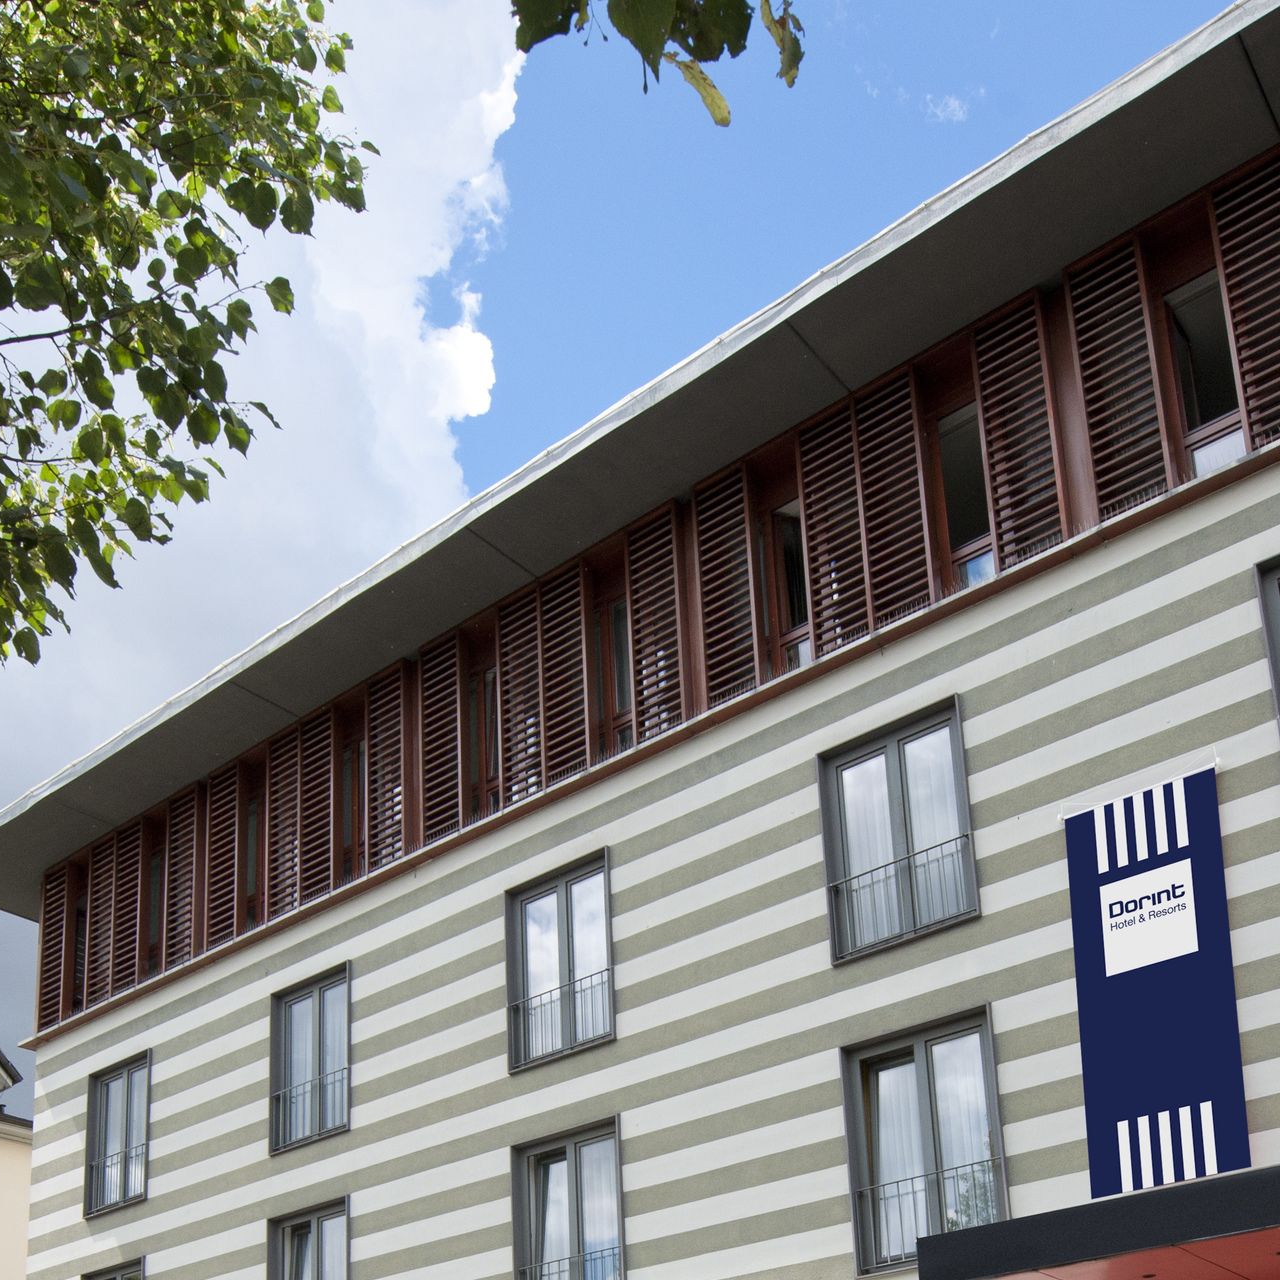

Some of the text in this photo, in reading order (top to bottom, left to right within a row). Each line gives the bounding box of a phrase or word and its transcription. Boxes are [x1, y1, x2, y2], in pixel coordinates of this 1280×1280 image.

[1108, 883, 1186, 919] Dorint
[1110, 902, 1187, 931] Hotel & Resorts
